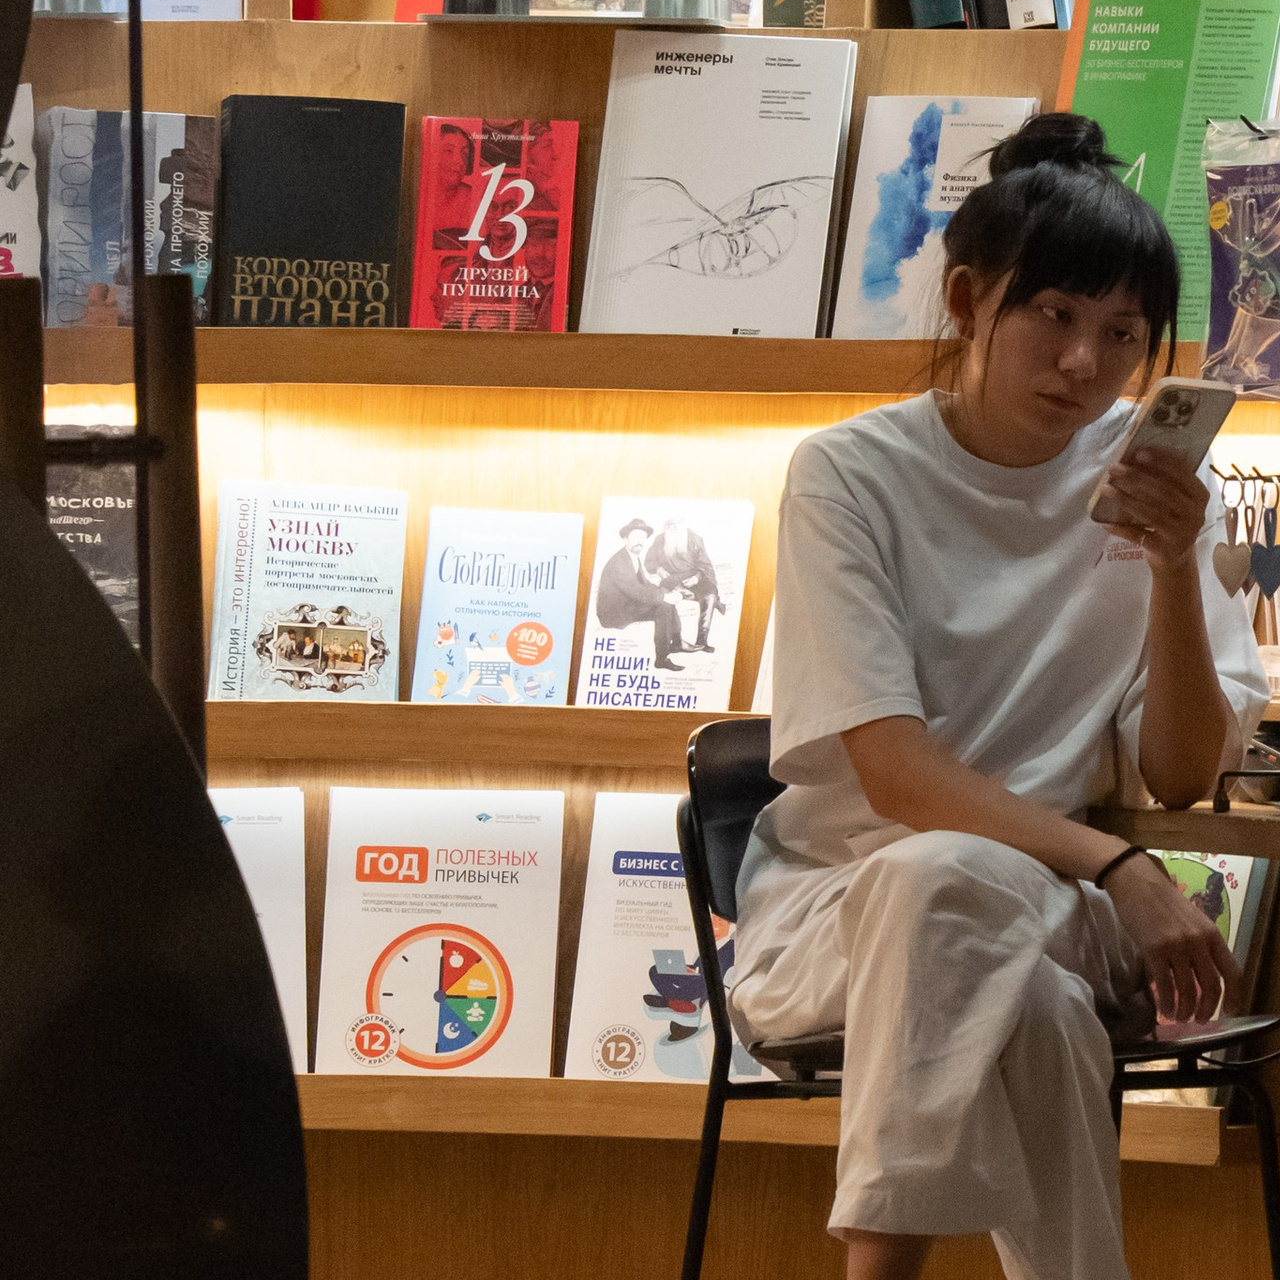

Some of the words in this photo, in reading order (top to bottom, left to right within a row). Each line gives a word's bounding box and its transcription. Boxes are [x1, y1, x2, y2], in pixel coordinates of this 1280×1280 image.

[1095, 6, 1144, 18] НАВЫКИ
[1092, 22, 1160, 36] КОМПАНИИ
[1089, 40, 1150, 52] БУДУЩЕГО
[656, 51, 734, 66] инженеры
[654, 65, 702, 76] мечты
[942, 172, 978, 182] Физика
[171, 172, 185, 252] ПРОХОЖЕГО
[458, 162, 536, 262] 13
[196, 211, 212, 279] ПОХОЖИЙ
[455, 266, 530, 282] ДРУЗЕЙ
[442, 283, 540, 299] ПУШКИНА
[272, 499, 340, 512] АЛЕКСАНДР
[344, 504, 400, 516] ВАСЬКИН
[268, 518, 340, 538] УЗНАЙ
[56, 532, 102, 544] ТСТВА
[234, 498, 251, 583] интересно!
[266, 537, 359, 557] МОСКВУ
[266, 556, 340, 570] Исторические
[264, 569, 314, 580] портреты
[319, 573, 379, 584] московских
[264, 580, 394, 596] достопримечательностей
[232, 588, 244, 612] это
[487, 600, 530, 610] НАПИСАТЬ
[454, 607, 501, 616] ОТЛИЧНУЮ
[502, 610, 542, 619] ИСТОРИЮ
[512, 628, 548, 647] +100
[594, 638, 617, 652] НЕ
[222, 628, 242, 692] История
[592, 655, 650, 671] ПИШИ!
[589, 673, 612, 688] НЕ
[616, 674, 661, 692] БУДЬ
[586, 691, 698, 710] ПИСАТЕЛЕМ!
[236, 814, 256, 822] Smart
[257, 814, 284, 824] Reading
[496, 813, 514, 822] Smart
[516, 814, 542, 822] Reading
[364, 852, 421, 880] ГОД
[436, 849, 539, 868] ПОЛЕЗНЫХ
[620, 858, 668, 870] БИЗНЕС
[670, 860, 680, 871] С
[435, 869, 520, 884] ПРИВЫЧЕК
[618, 879, 688, 890] ИСКУССТВЕНН
[616, 900, 659, 908] ВИЗУАЛЬНЫЙ
[613, 922, 654, 930] ИНТЕЛЛЕКТА
[619, 916, 679, 924] ИСКУССТВЕННОГО
[351, 1016, 396, 1034] ИНФОГРАФИК
[360, 1030, 386, 1050] 12
[598, 1026, 642, 1046] ИНФОГРАФИК
[350, 1048, 366, 1063] КНИГ
[368, 1050, 395, 1064] КРАТКО
[606, 1042, 631, 1062] 12
[596, 1059, 612, 1074] КНИГ
[613, 1061, 640, 1076] КРАТКО
